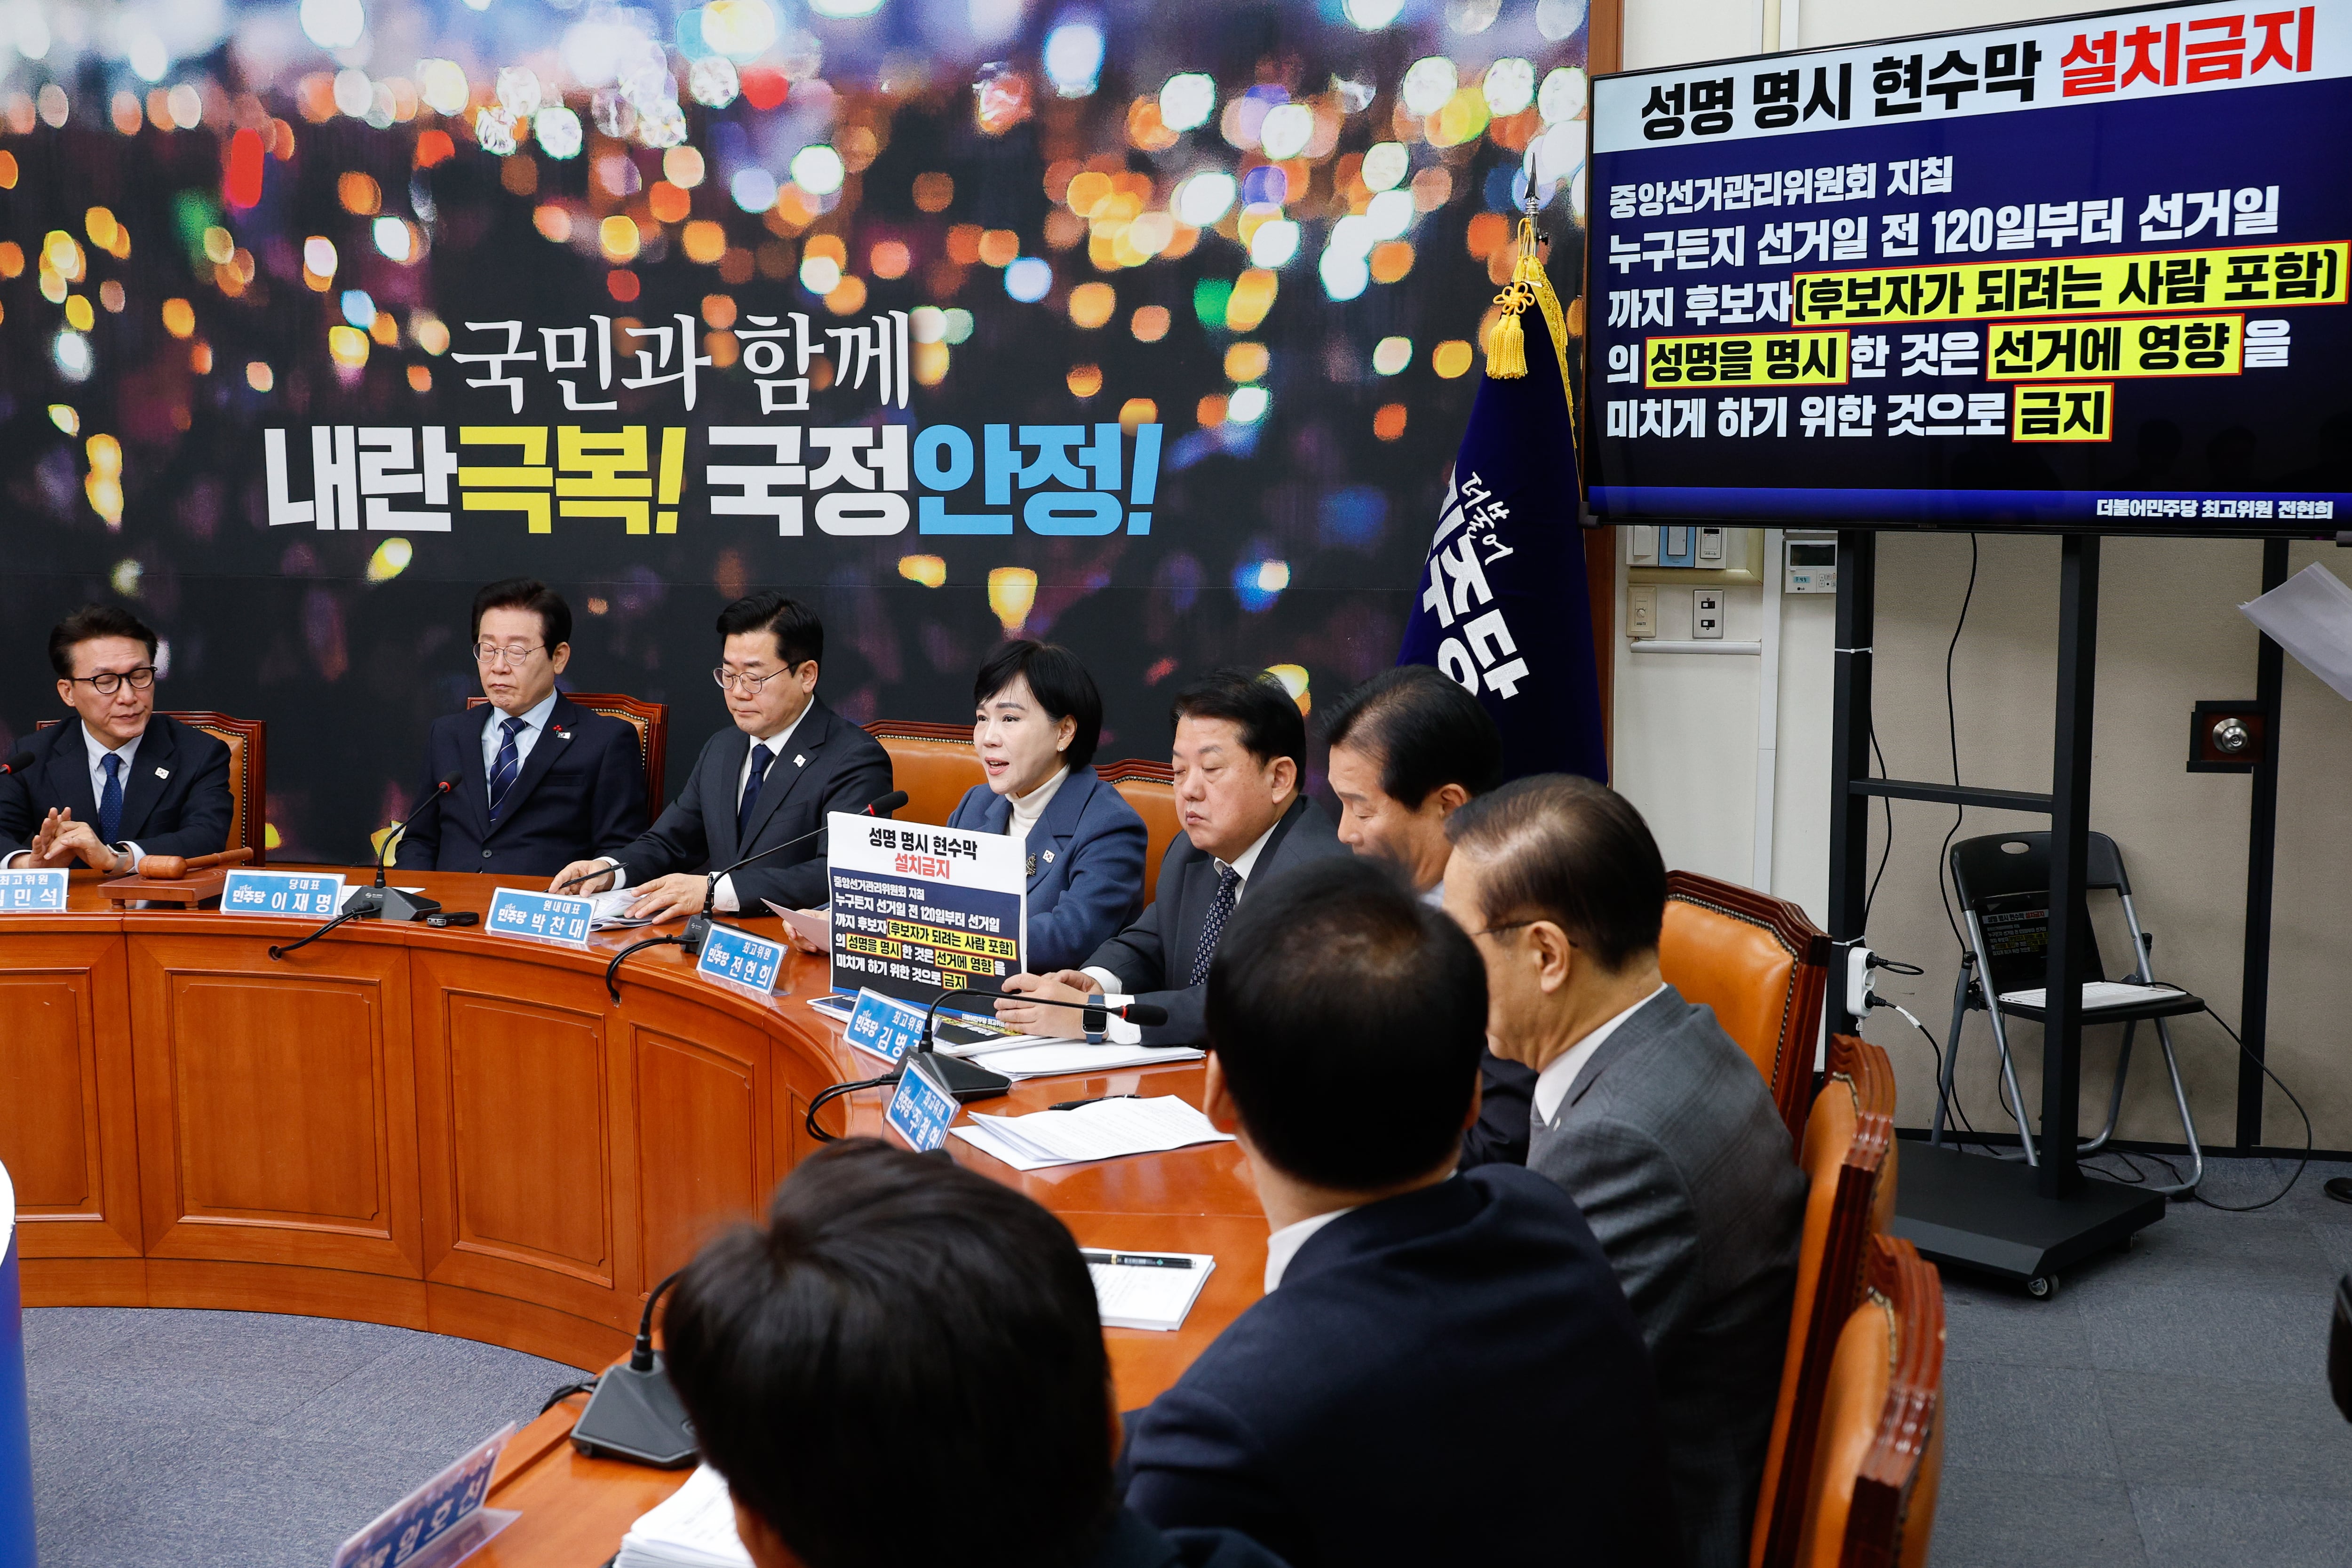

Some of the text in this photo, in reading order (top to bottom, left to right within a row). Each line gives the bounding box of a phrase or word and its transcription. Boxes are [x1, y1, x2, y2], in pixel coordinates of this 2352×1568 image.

[1642, 6, 2316, 139] 성명 명시 현수막 설치금지
[1610, 156, 1954, 219] 중앙선거관리위원회 지침
[1609, 185, 2279, 273] 누구든지 선거일 전 120일부터 선거일
[1608, 287, 1673, 328] 까지
[1977, 267, 2102, 315] 되려는
[2117, 264, 2211, 307] 사람
[2225, 248, 2338, 302] 포함)
[452, 311, 909, 414] 국민과 함께
[1607, 343, 1639, 384] 의
[1651, 338, 1755, 381] 성명을
[1901, 330, 1979, 376] 것은
[1995, 326, 2119, 374] 선거에
[1607, 390, 2105, 439] 미치게 하기 위한 것으로 금지
[264, 422, 1163, 537] 내란극복! 국정안정!
[2097, 497, 2333, 520] 더불어민주당 최고위원 전현희
[869, 827, 977, 860] 성명 명시 현수막
[0, 875, 48, 885] 최고위원
[895, 852, 949, 879] 설치금지
[232, 890, 331, 913] 민주당 이재명
[289, 879, 320, 890] 당대표
[834, 876, 924, 901] 중앙선거관리위원회 지침
[497, 908, 584, 938] 민주당 박찬대
[543, 900, 580, 915] 원내대표
[835, 892, 1000, 933] 누구든지 선거일 전 120일부터 선거일
[742, 942, 771, 960] 최고위원
[835, 913, 854, 929] 까지
[932, 929, 961, 948] 되려는
[965, 936, 985, 951] 사람
[989, 939, 1013, 955] 포함)
[835, 933, 845, 948] 의
[849, 937, 877, 951] 성명을
[915, 947, 934, 963] 것은
[937, 952, 967, 969] 선거에
[707, 948, 771, 987] 민주당 전현희
[836, 954, 966, 989] 미치게 하기 위한 것으로 금지
[854, 1015, 920, 1057] 민주당 김병
[892, 1011, 924, 1034] 최고위원
[896, 1090, 914, 1118] 민주당
[921, 1090, 946, 1120] 최고위원
